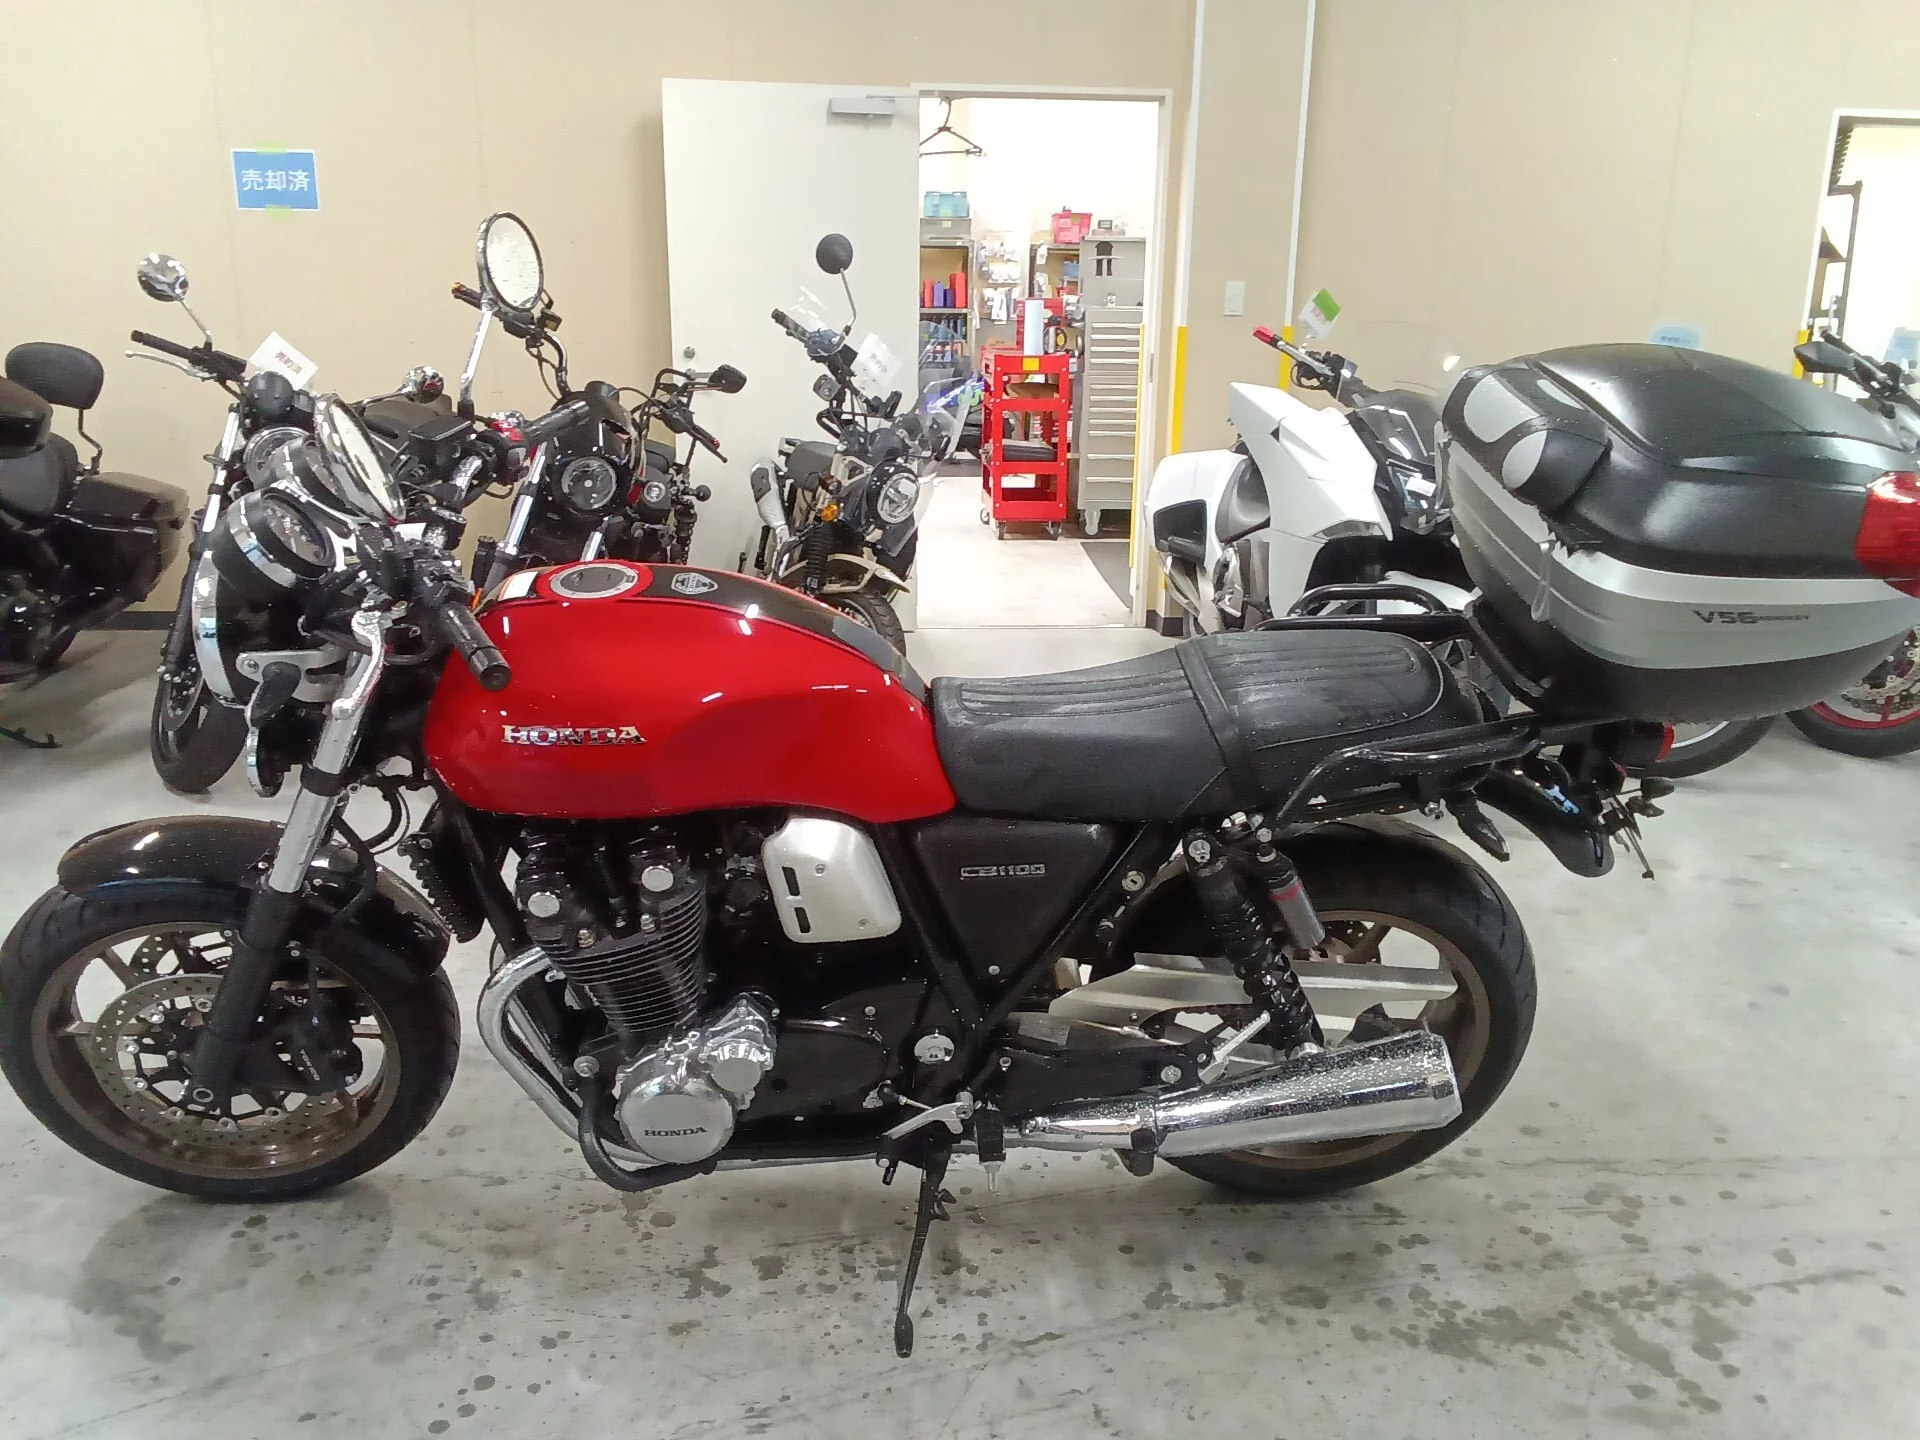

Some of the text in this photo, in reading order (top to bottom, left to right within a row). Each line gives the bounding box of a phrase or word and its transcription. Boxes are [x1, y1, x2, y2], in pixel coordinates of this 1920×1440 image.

[241, 168, 310, 192] 売却済
[501, 724, 648, 746] HONDA
[960, 863, 1046, 877] CB1100
[643, 1126, 708, 1137] HONDA
